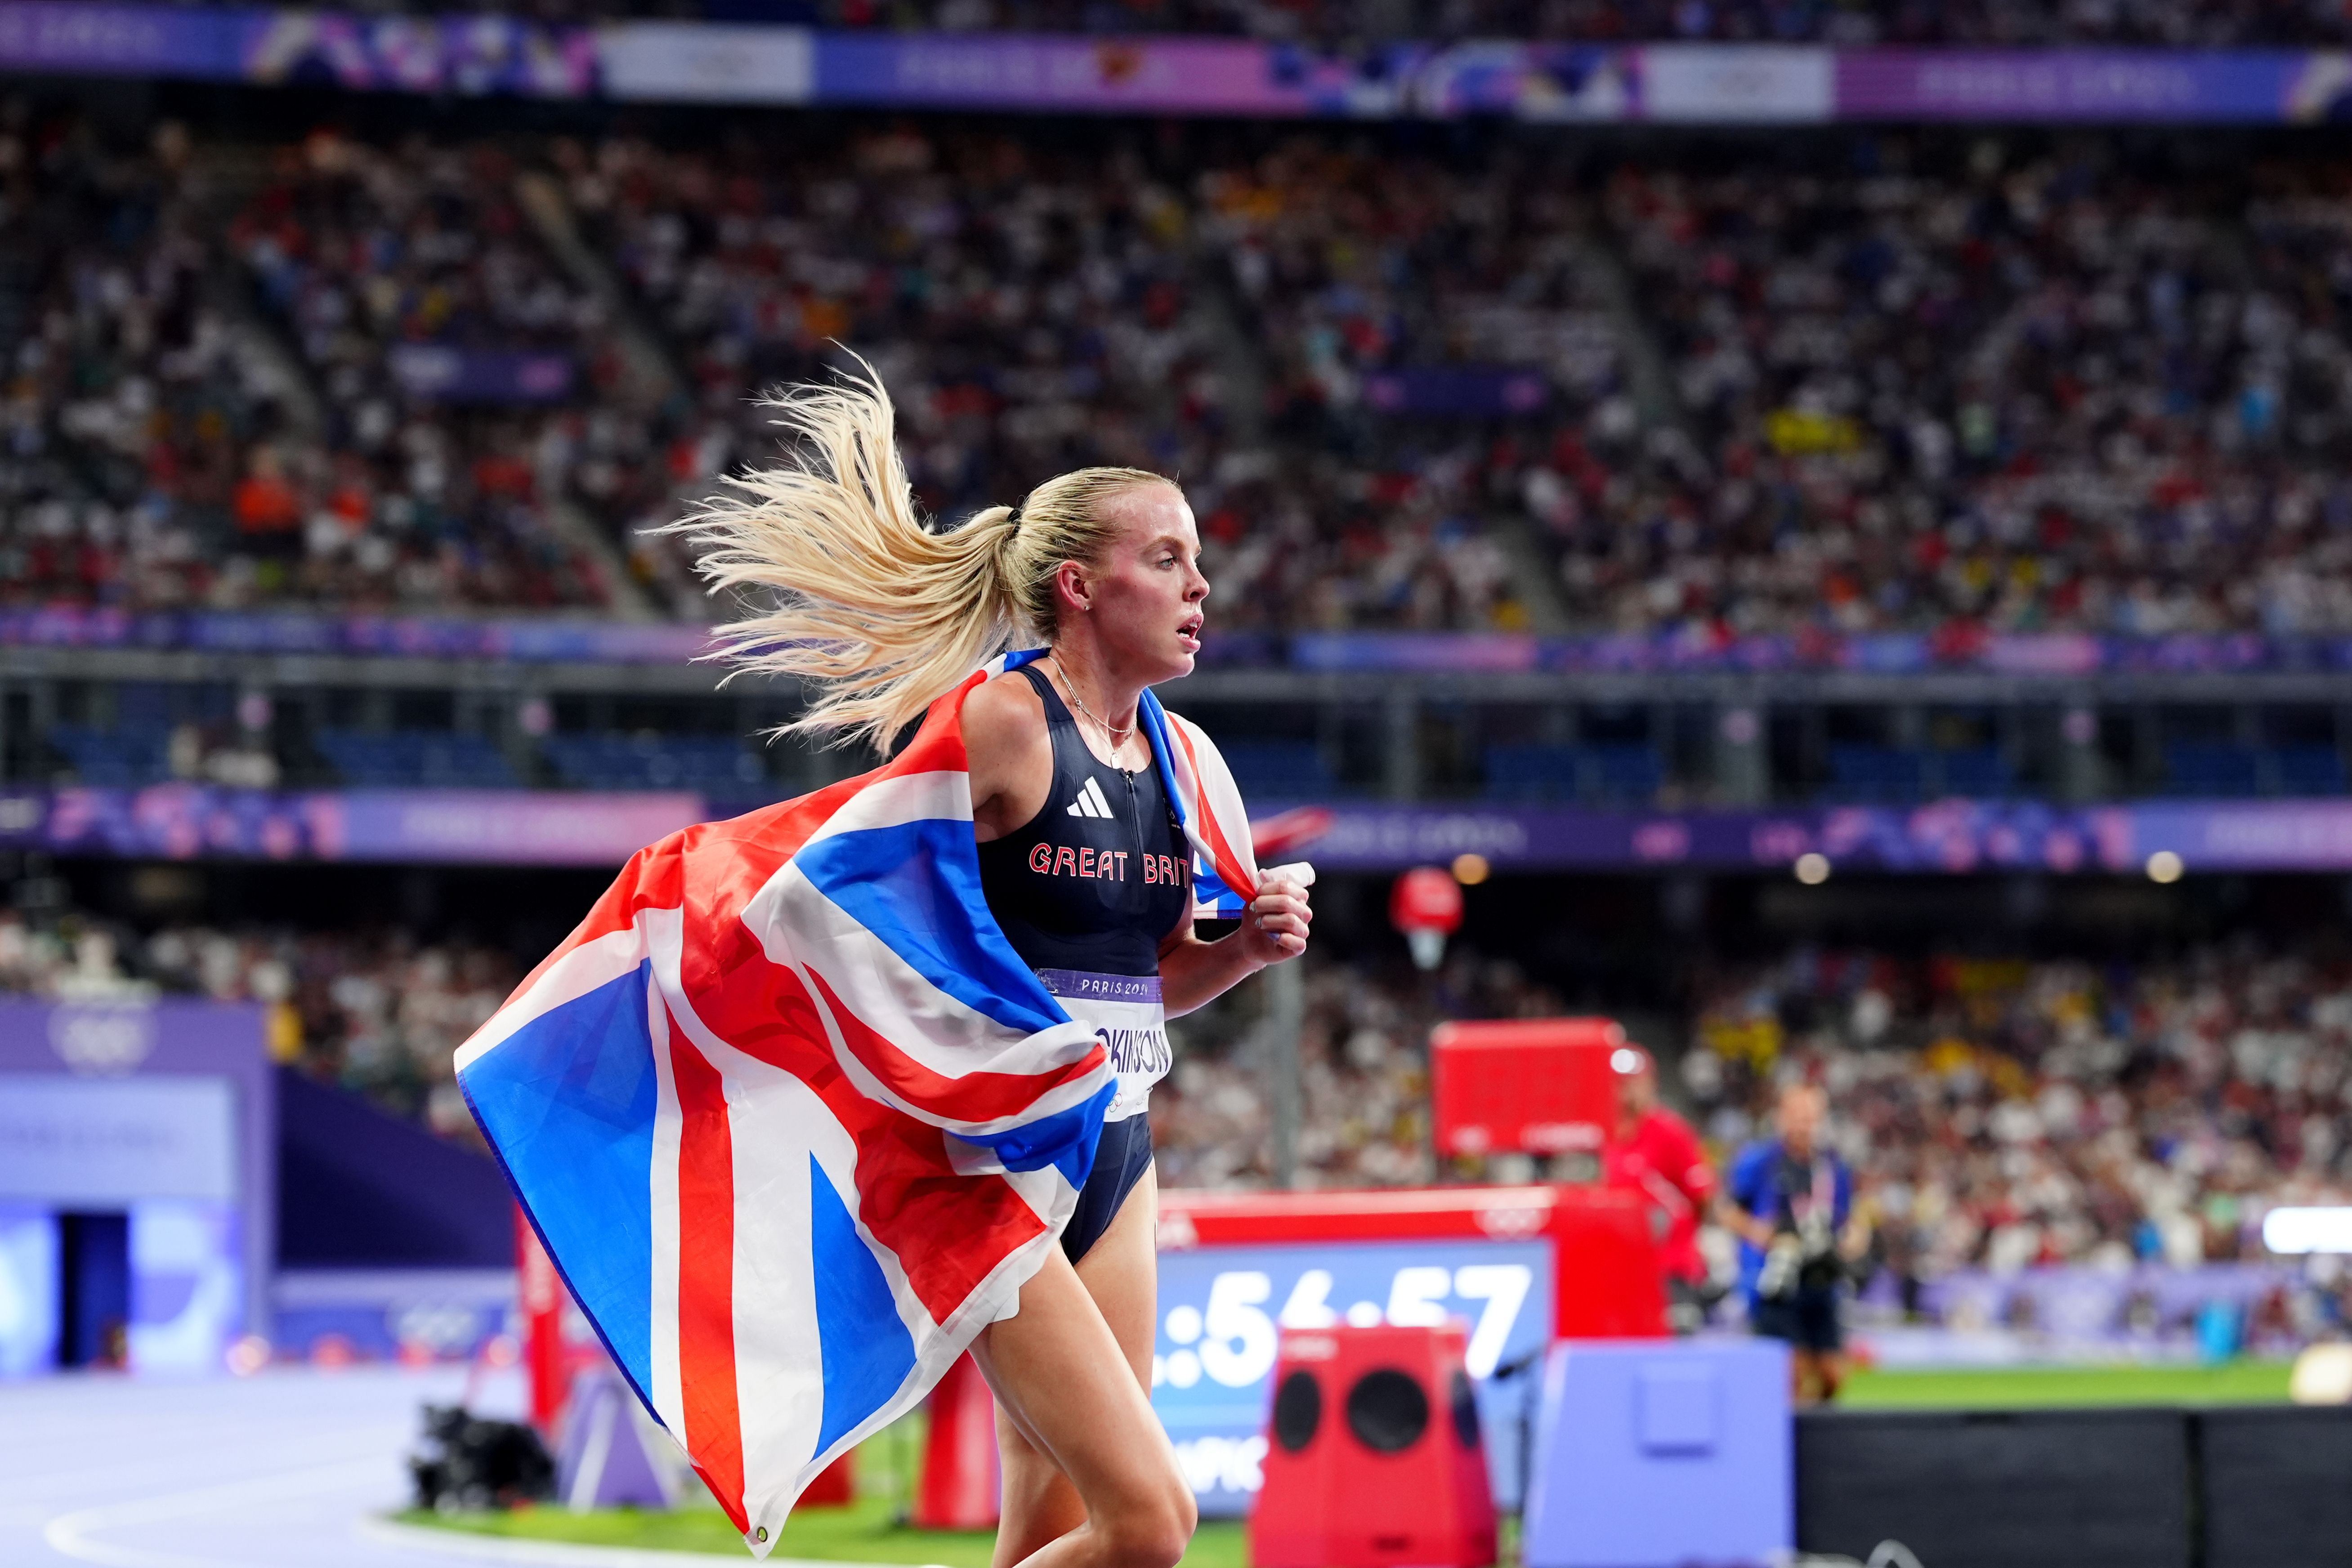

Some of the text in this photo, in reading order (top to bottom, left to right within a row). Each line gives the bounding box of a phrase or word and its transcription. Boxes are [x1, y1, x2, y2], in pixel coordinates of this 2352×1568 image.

[1029, 842, 1189, 889] GREAT BRIT
[1125, 983, 1148, 996] 2024
